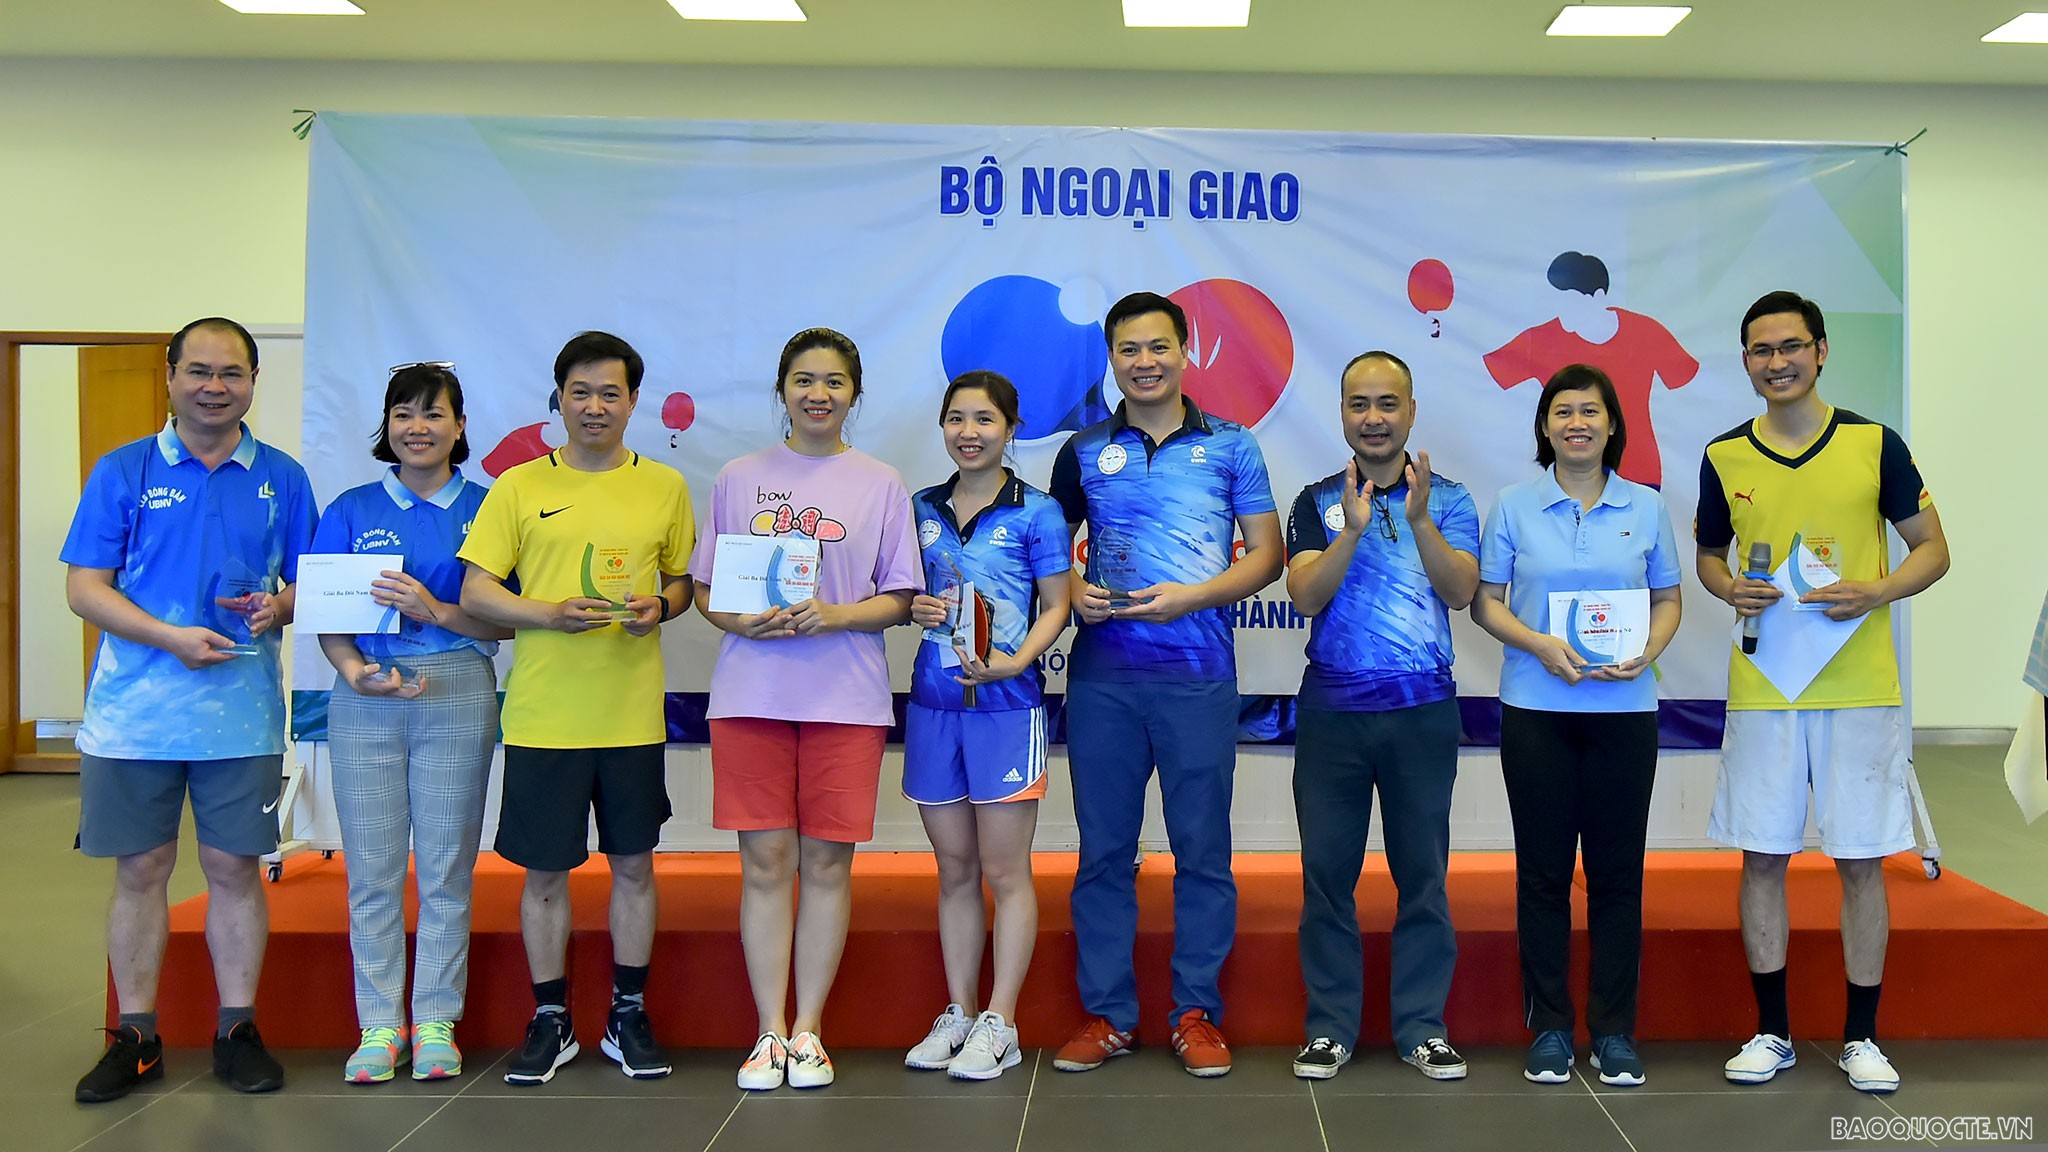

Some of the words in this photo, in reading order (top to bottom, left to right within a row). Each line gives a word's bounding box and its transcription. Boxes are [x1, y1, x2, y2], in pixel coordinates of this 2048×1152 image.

[939, 155, 1003, 227] BỘ
[1021, 165, 1171, 229] NGOẠI
[1189, 170, 1300, 222] GIAO
[757, 485, 792, 504] bow
[148, 497, 173, 510] UBNV
[362, 538, 390, 551] UBNV
